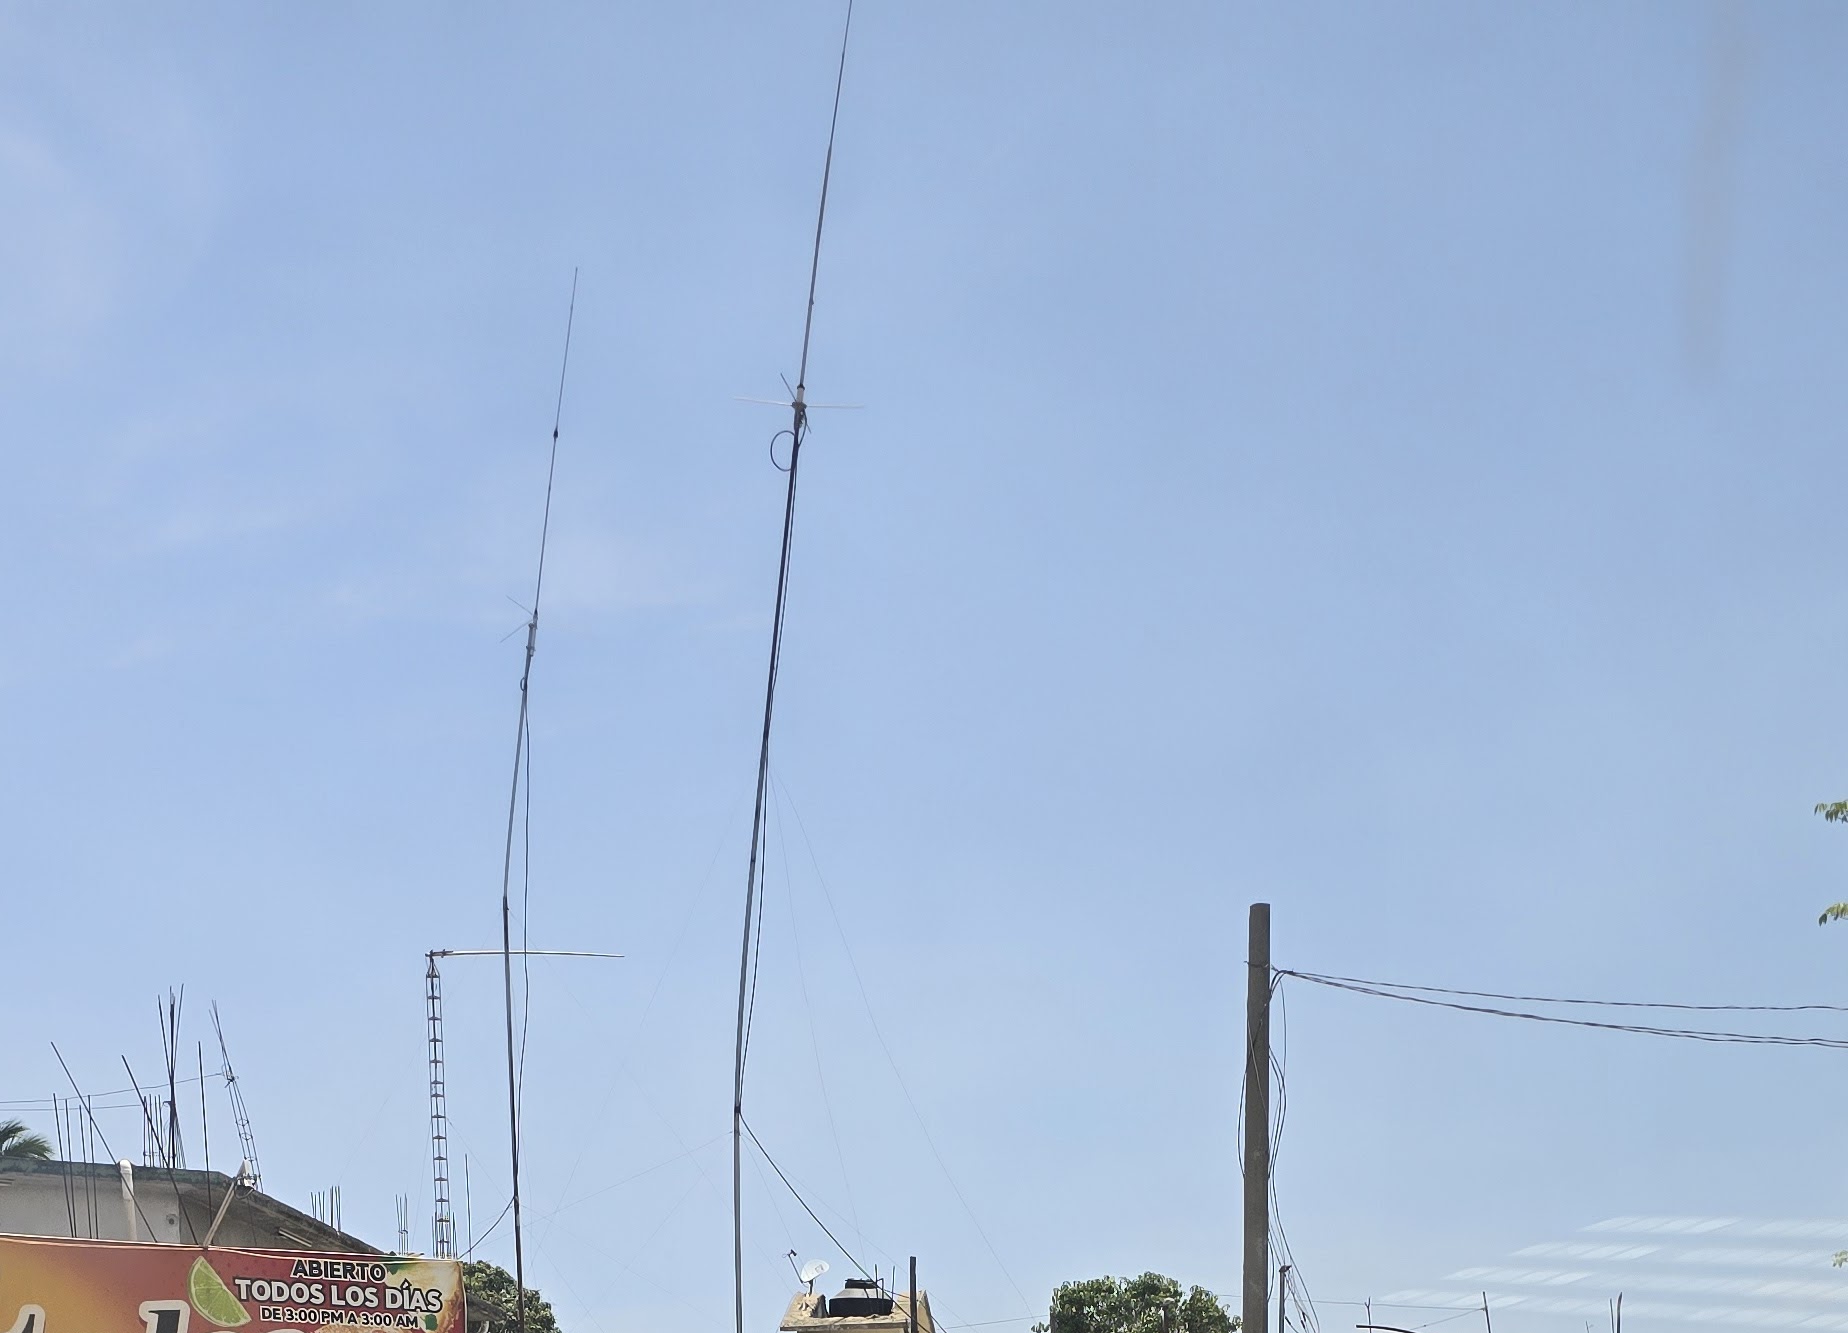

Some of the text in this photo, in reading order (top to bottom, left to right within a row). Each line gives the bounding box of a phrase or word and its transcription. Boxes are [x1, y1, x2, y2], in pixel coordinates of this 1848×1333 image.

[292, 1259, 386, 1282] ABIERTO
[234, 1278, 442, 1312] TODOS LOS DÍAS
[261, 1307, 419, 1328] DE 3:00 PM A 3:00 AM
